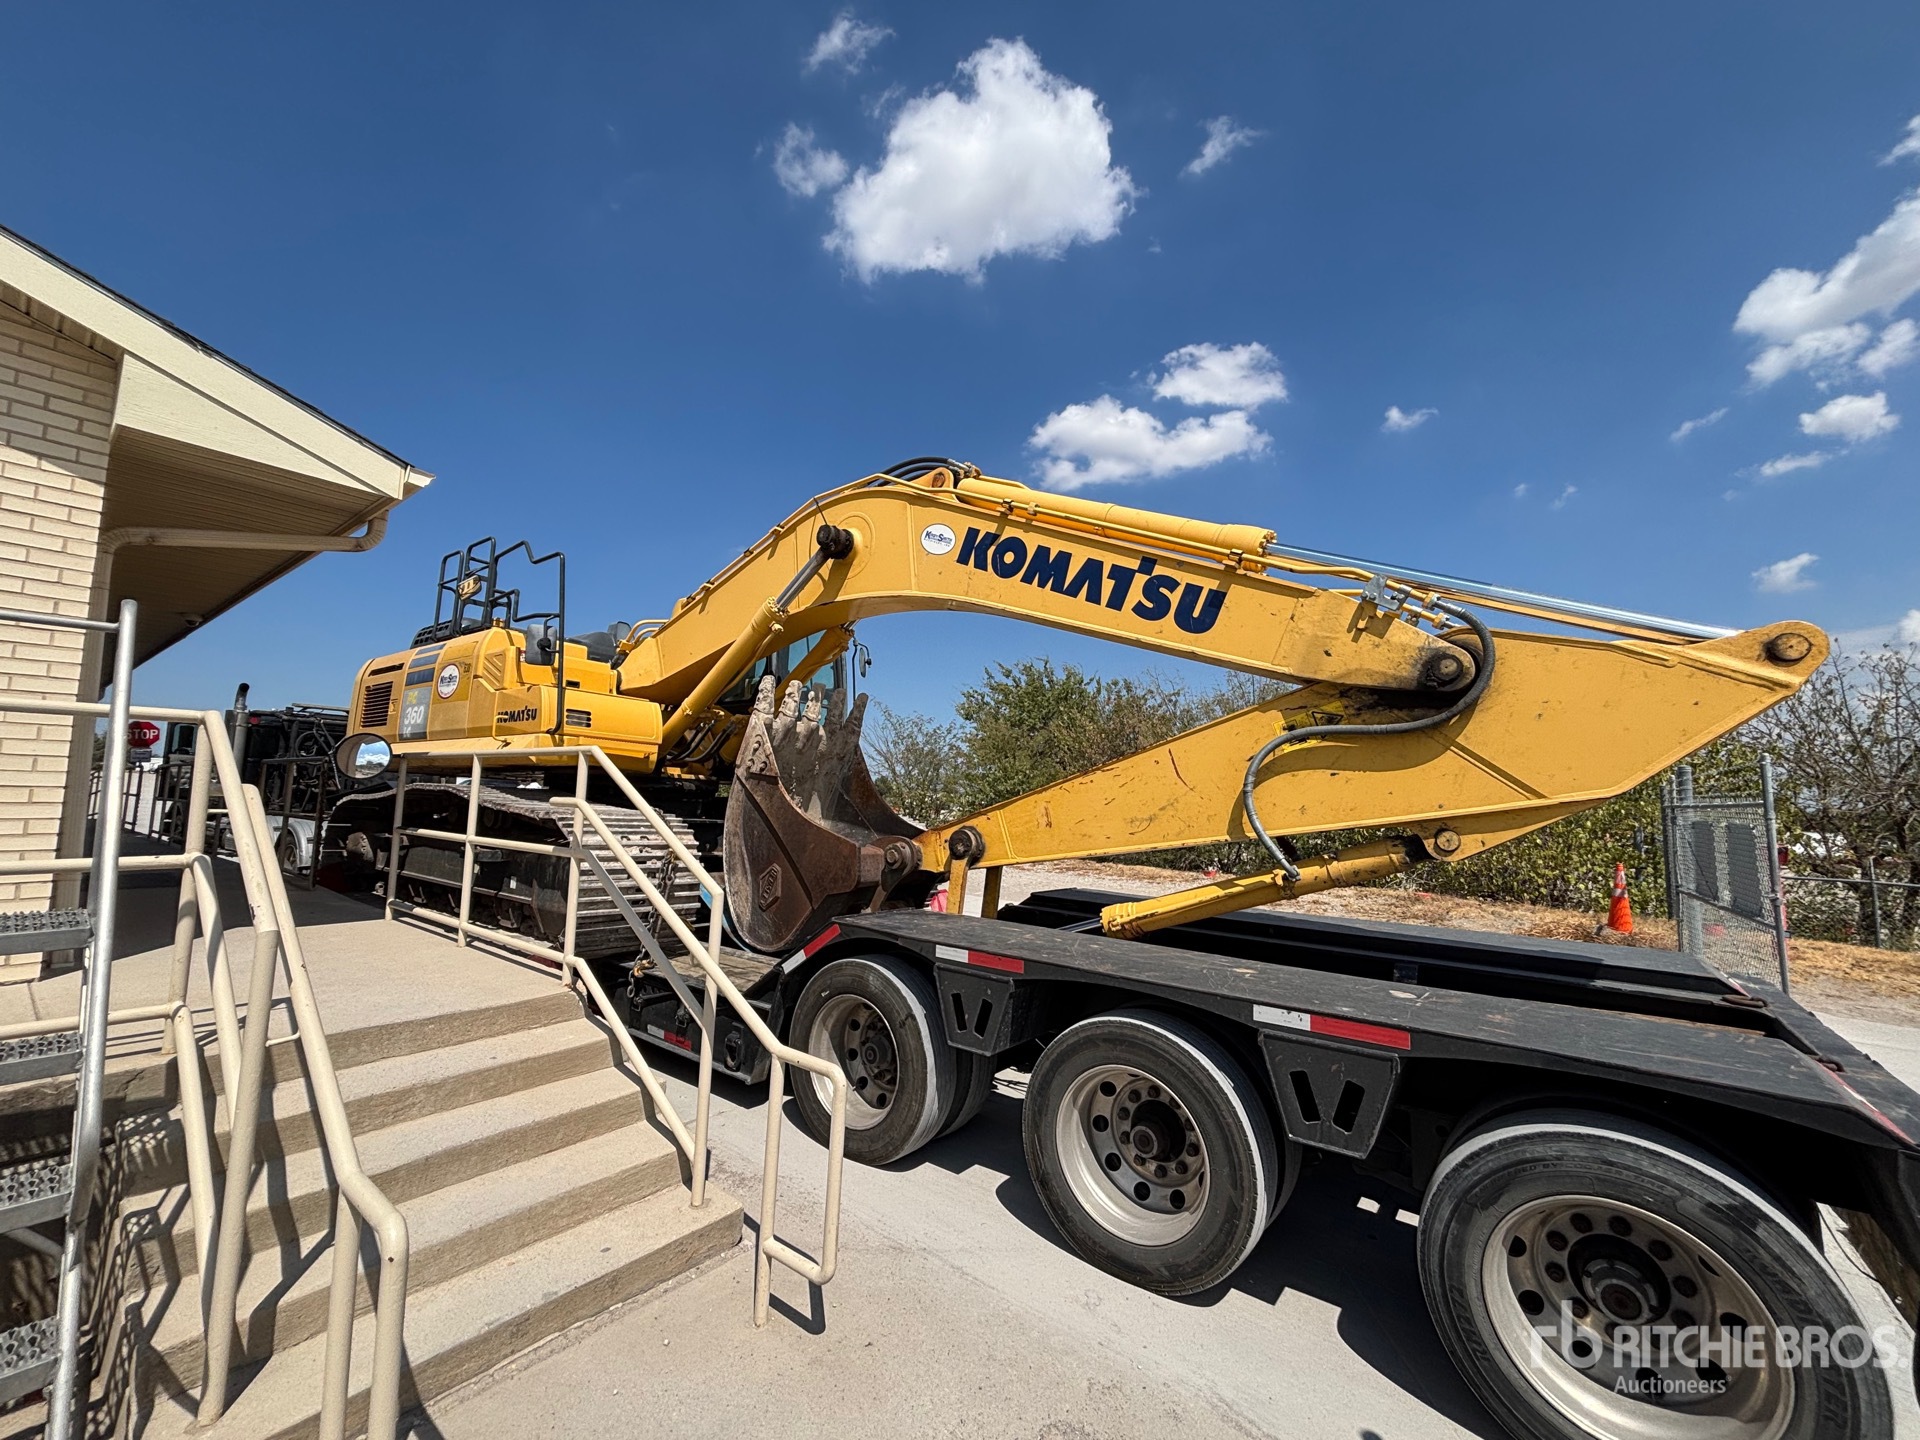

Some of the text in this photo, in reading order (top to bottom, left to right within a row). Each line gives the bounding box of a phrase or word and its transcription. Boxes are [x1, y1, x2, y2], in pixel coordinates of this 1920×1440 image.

[956, 527, 1227, 634] KOMATSU
[404, 705, 425, 725] 360
[497, 706, 537, 723] KOMATSU
